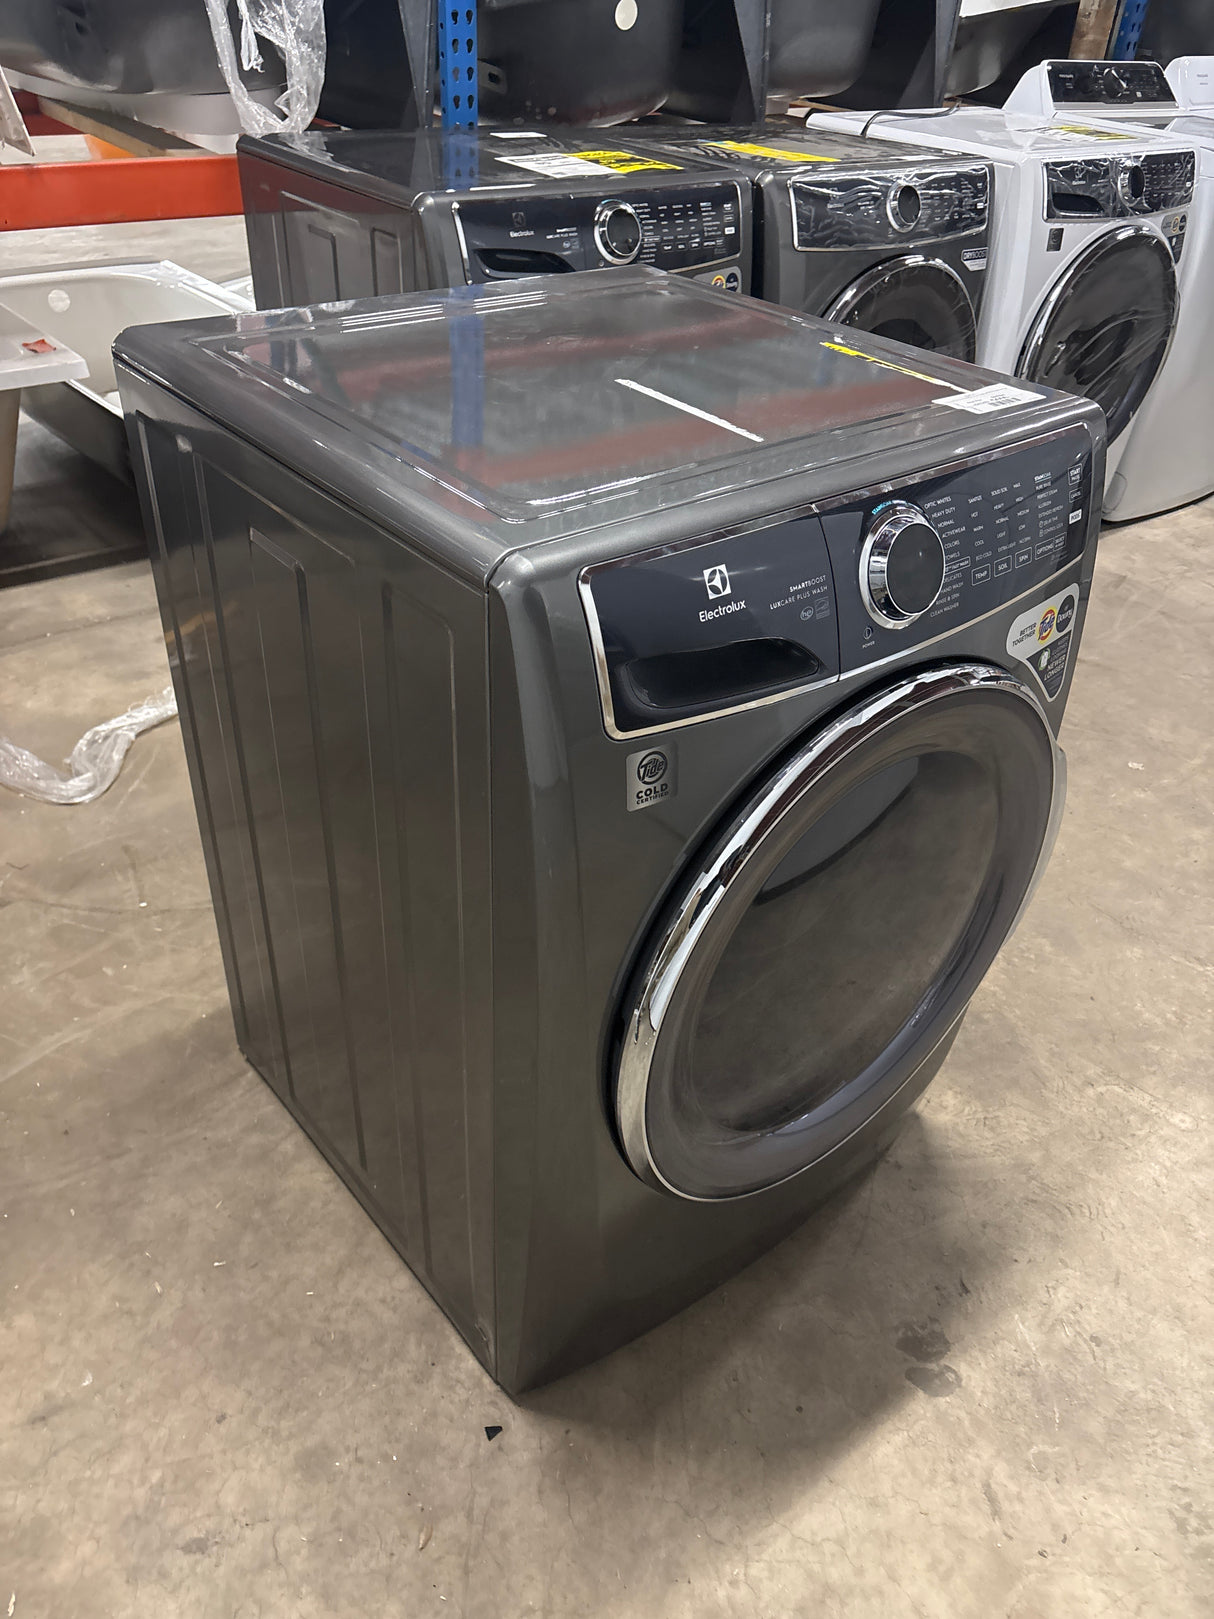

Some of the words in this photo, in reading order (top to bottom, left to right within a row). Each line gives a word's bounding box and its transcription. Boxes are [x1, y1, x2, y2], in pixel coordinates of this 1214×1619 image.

[924, 501, 937, 509] OPTIC
[938, 496, 952, 505] WHITES
[931, 510, 944, 518] HEAVY
[938, 519, 955, 528] NORMAL
[942, 526, 966, 538] ACTIVEWEAR
[944, 540, 960, 549] COLORS
[1037, 542, 1054, 555] OPTIONS
[998, 562, 1008, 571] SOIL
[975, 570, 987, 580] TEMP
[789, 575, 826, 593] SMARTBOOST
[769, 596, 796, 610] LUXCARE
[796, 591, 811, 601] PLUS
[811, 585, 828, 595] WASH
[699, 600, 747, 622] Electrolux
[1019, 622, 1037, 636] BETTER
[1012, 629, 1036, 647] TOGETHER
[640, 758, 665, 781] Tide
[636, 783, 668, 799] COLD
[636, 791, 669, 805] CERTIFIED
